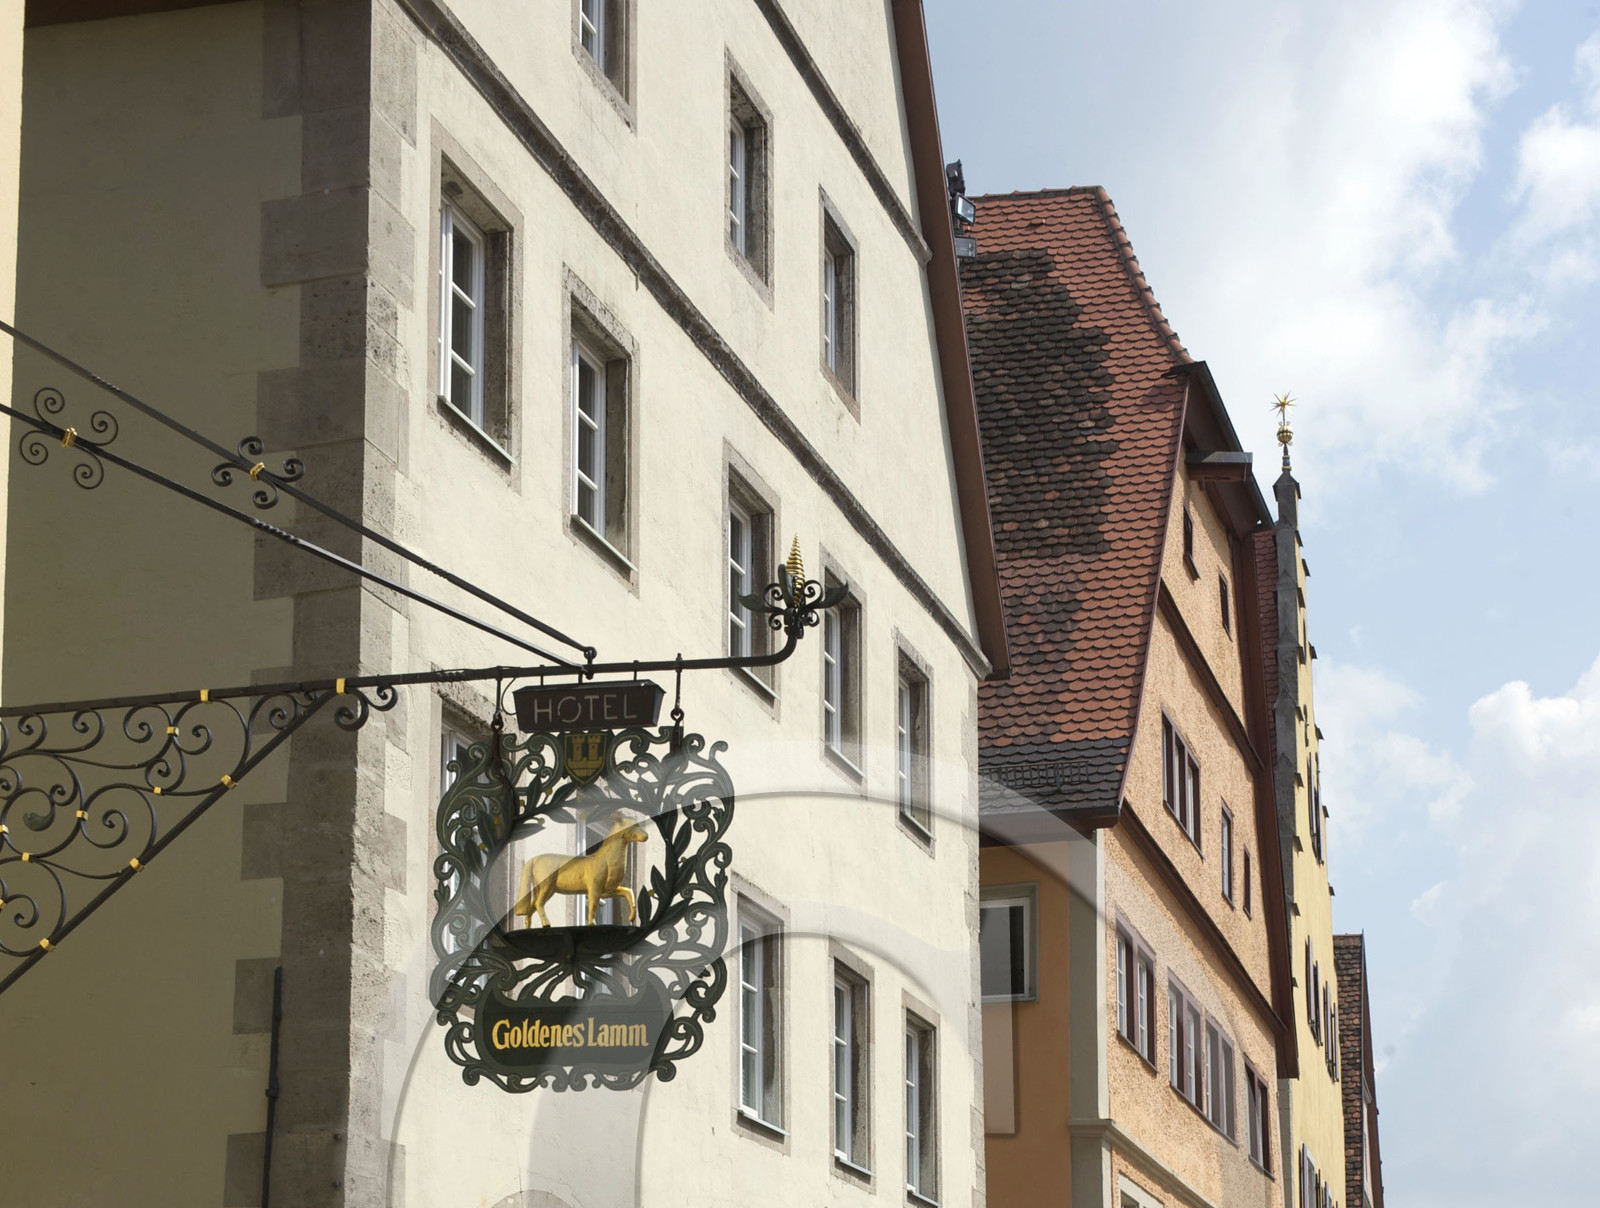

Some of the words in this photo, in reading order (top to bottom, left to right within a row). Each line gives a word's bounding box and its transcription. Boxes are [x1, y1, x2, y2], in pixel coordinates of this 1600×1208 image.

[534, 693, 638, 725] HOTEL
[491, 1018, 583, 1050] Goldenes
[587, 1017, 649, 1047] Lamm
